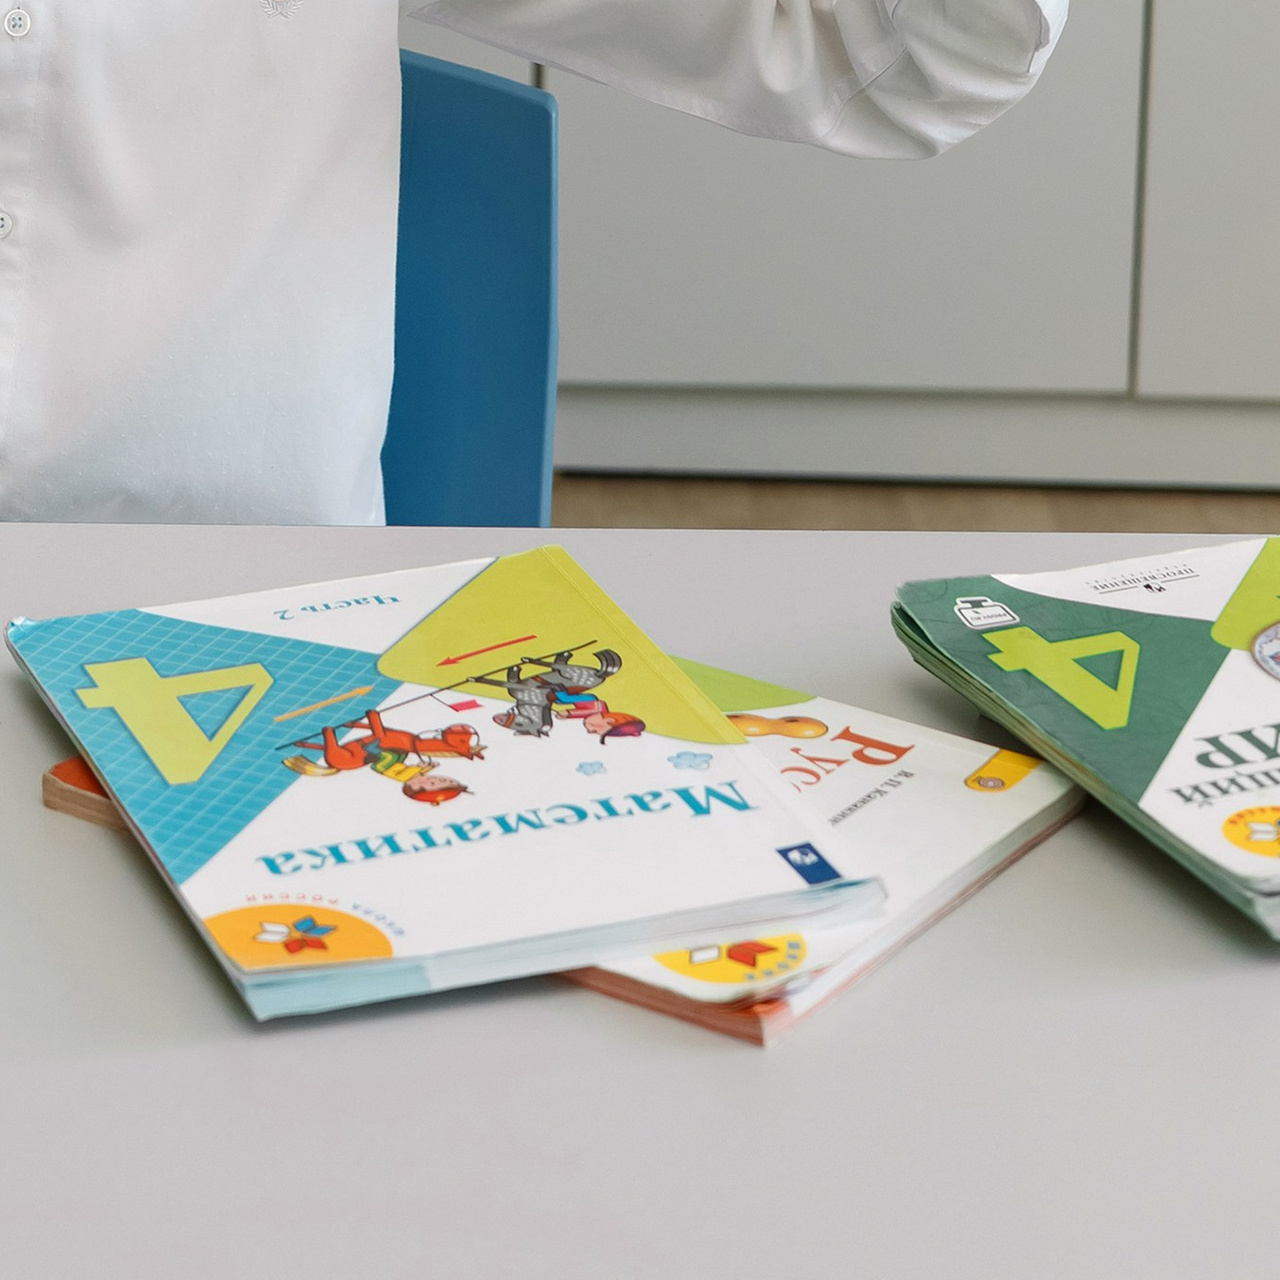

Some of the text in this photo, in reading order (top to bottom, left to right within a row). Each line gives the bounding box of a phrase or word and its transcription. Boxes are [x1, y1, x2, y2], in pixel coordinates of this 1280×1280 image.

[272, 594, 401, 621] Часть 2
[75, 656, 275, 786] 4
[981, 626, 1140, 731] 4
[780, 725, 915, 794] Рус
[256, 780, 761, 877] Математика
